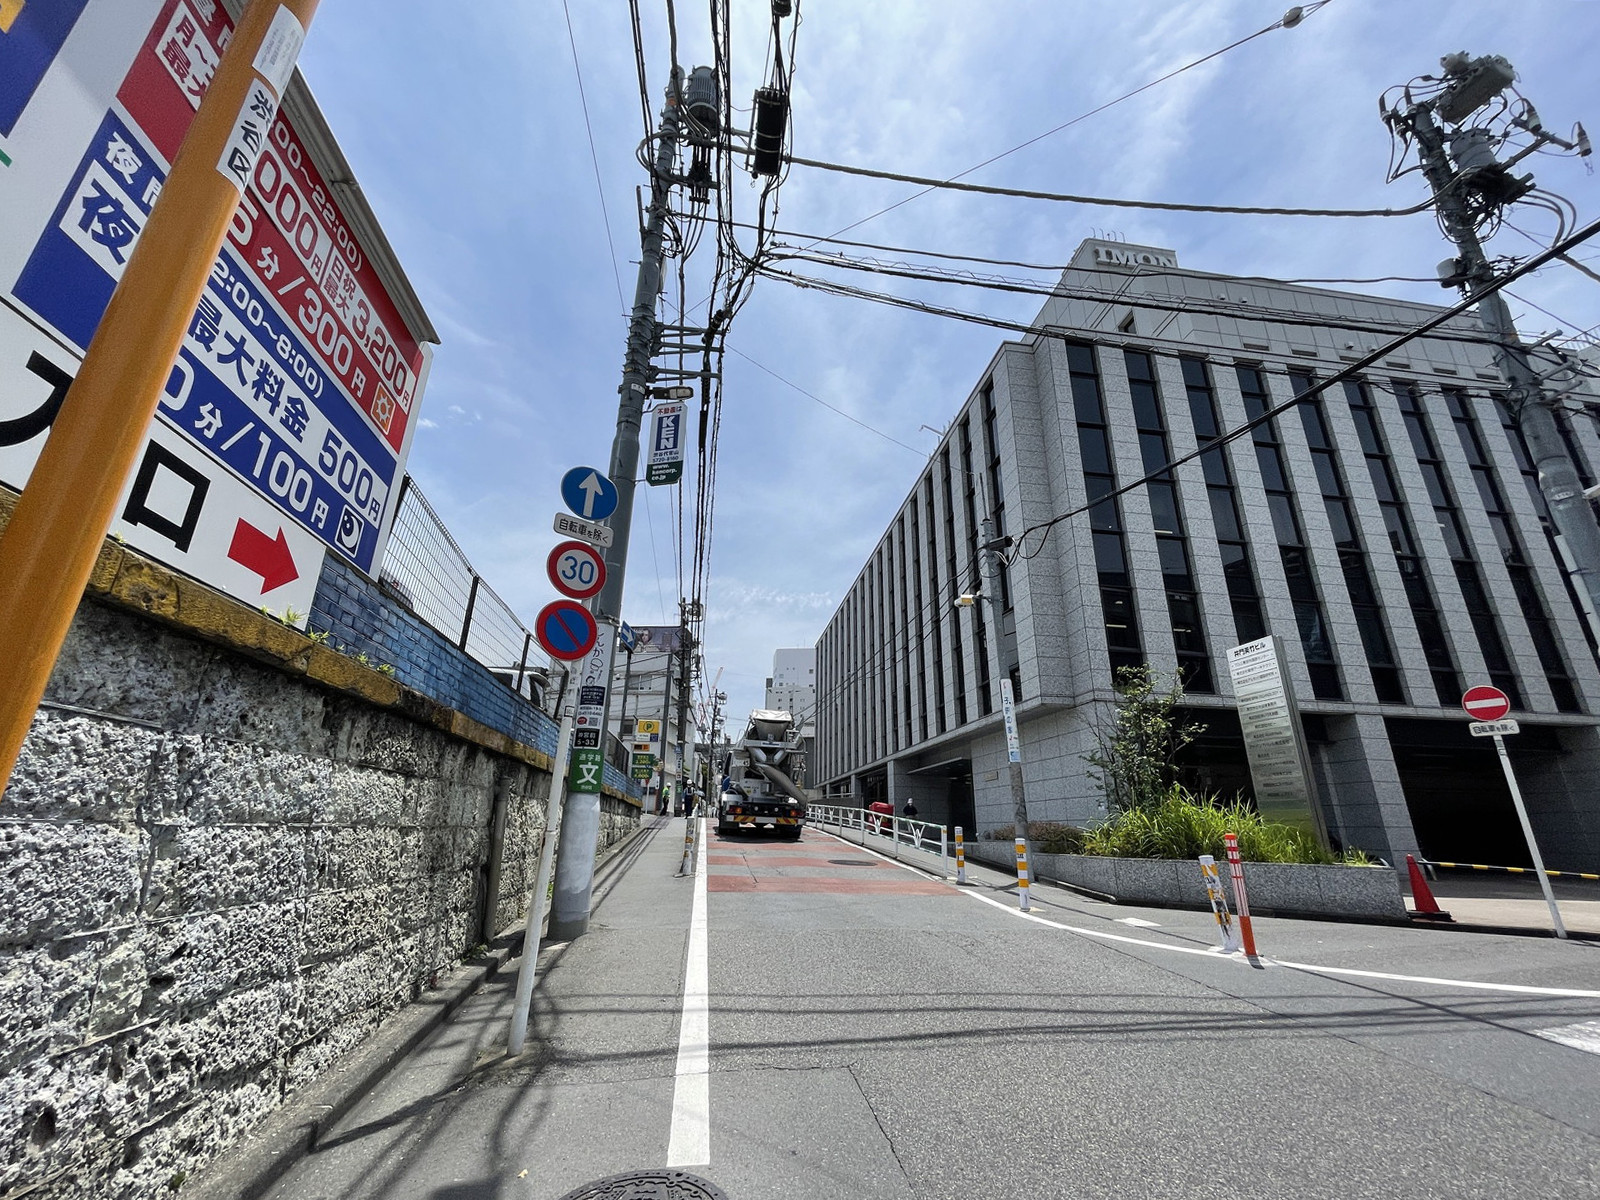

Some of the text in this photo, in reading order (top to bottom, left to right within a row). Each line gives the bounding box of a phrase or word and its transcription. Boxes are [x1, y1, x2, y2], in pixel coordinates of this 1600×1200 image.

[176, 14, 217, 81] 月〜
[227, 89, 275, 187] 渋谷区
[1094, 247, 1174, 268] IMON
[323, 273, 350, 319] 最大
[331, 255, 357, 300] 日祝
[77, 178, 141, 265] 夜
[319, 428, 381, 522] 500円
[352, 299, 410, 407] 3,200円
[658, 406, 682, 414] 不動産は
[660, 416, 675, 450] KEN
[560, 518, 608, 544] 自転車を除く
[562, 556, 594, 585] 30
[577, 761, 599, 785] 文
